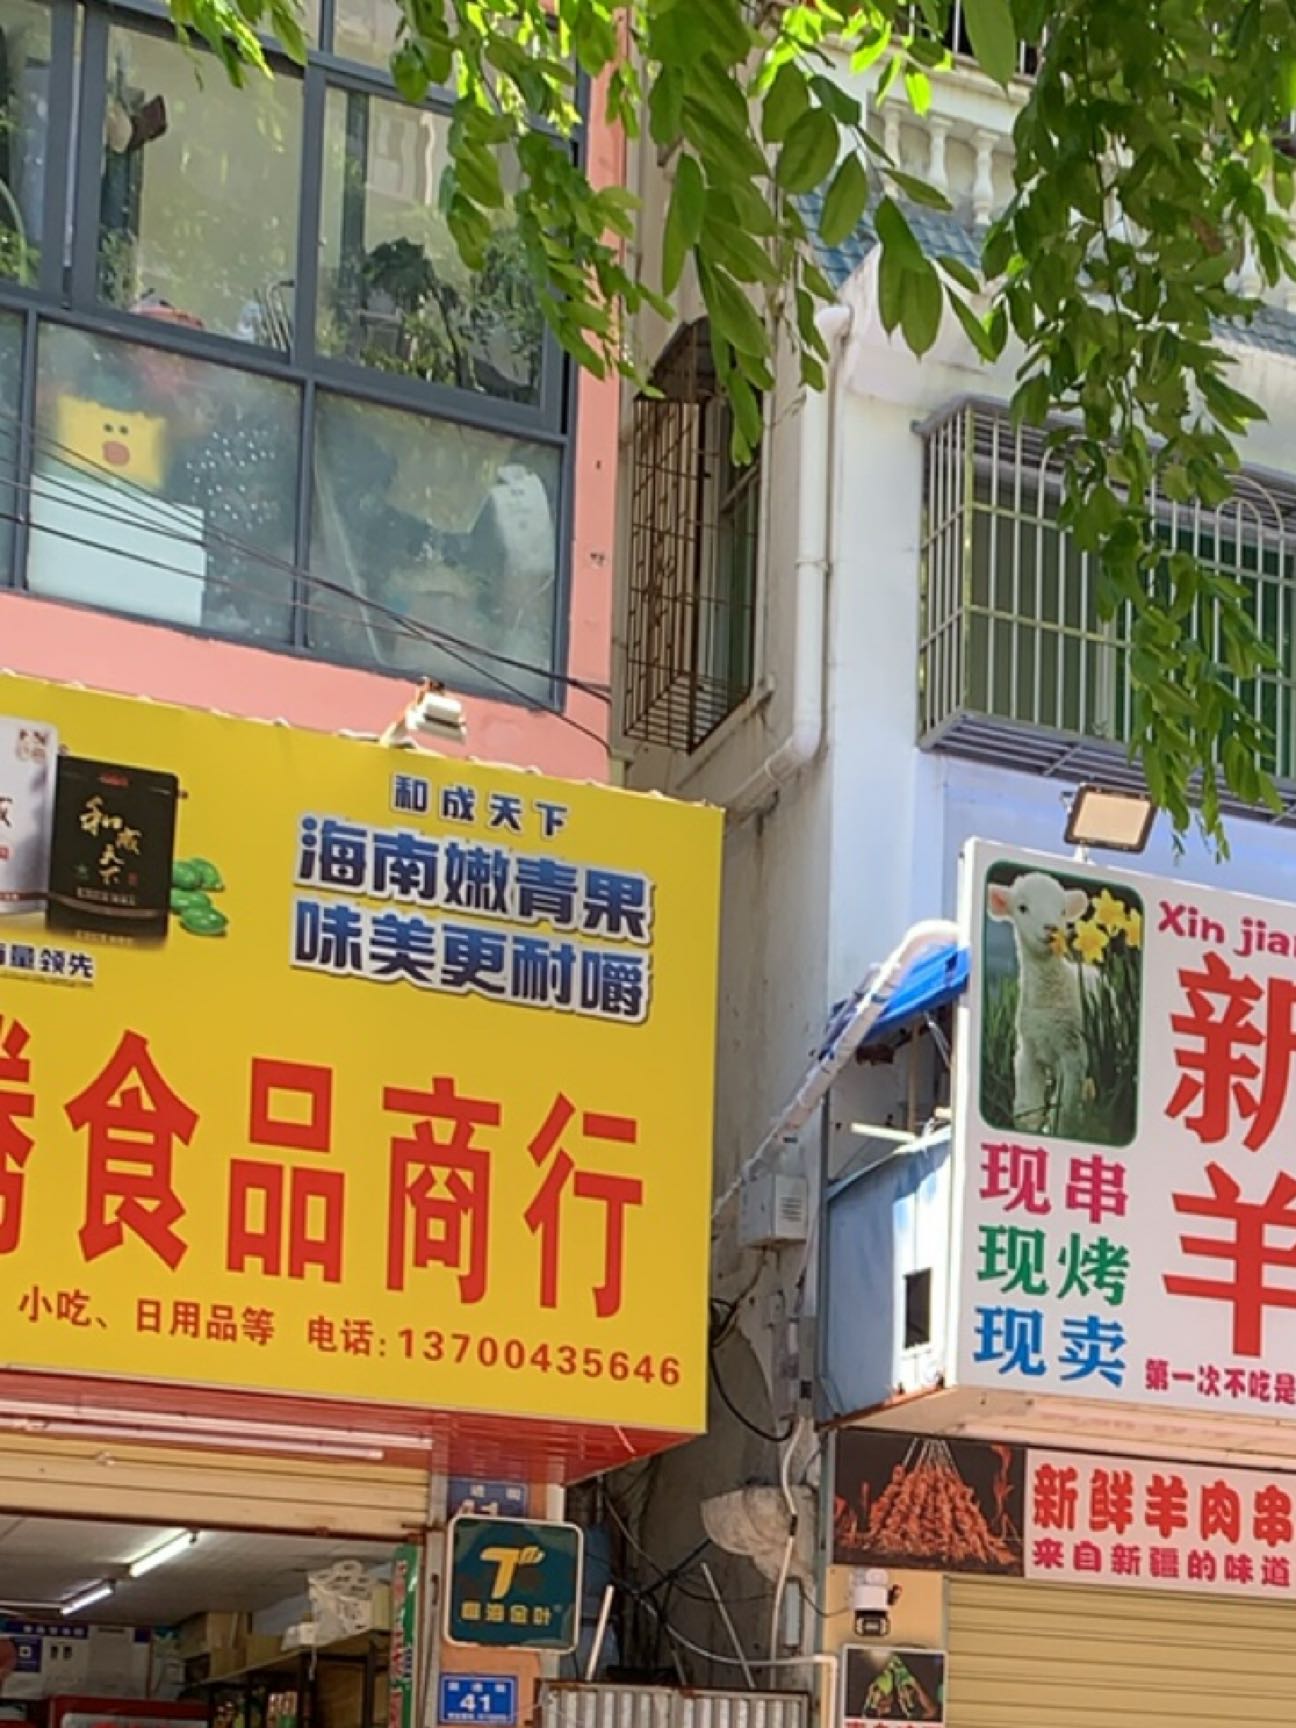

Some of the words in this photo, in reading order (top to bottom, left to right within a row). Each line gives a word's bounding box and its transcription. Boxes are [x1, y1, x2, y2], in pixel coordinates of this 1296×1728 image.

[394, 774, 569, 837] 和成天下
[299, 816, 647, 938] 海南嫩青果
[0, 943, 94, 979] 量领先
[294, 900, 644, 1017] 味美更耐嚼
[1158, 900, 1225, 944] Xin
[978, 1142, 1130, 1224] 现串
[976, 1225, 1131, 1306] 现烤
[973, 1307, 1128, 1387] 现卖
[1033, 1464, 1292, 1547] 新鲜羊肉串
[1033, 1538, 1291, 1587] 来自新疆的味道
[459, 1692, 492, 1713] 41
